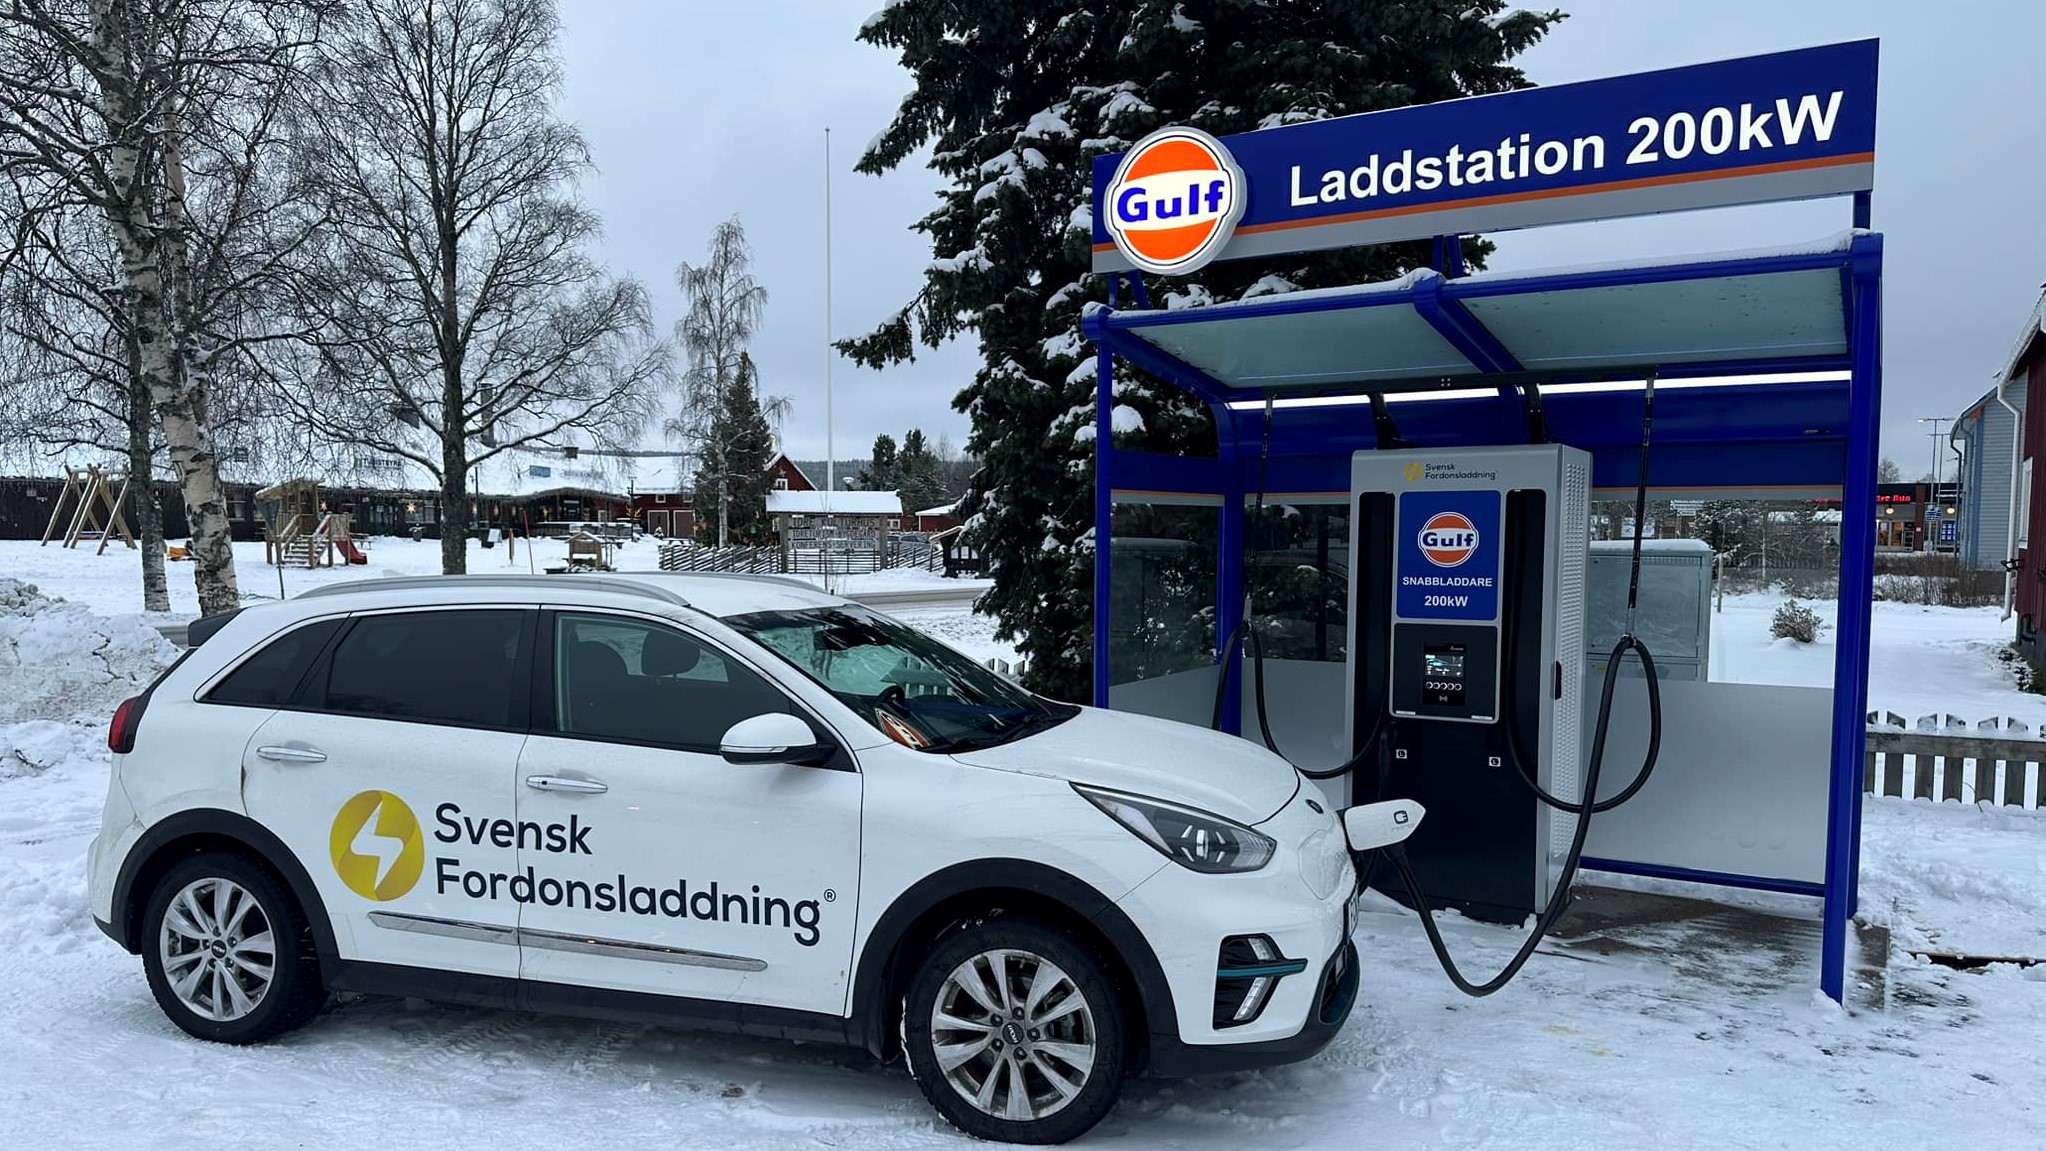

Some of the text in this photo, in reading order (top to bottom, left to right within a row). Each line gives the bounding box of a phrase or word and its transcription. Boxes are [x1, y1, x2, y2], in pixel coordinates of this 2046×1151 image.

[1290, 90, 1845, 208] Laddstation 200kW
[1117, 179, 1225, 223] Gulf
[1425, 463, 1455, 471] Svensk
[793, 517, 875, 527] IDRE KULTURHUS
[1422, 532, 1475, 547] Gulf
[1402, 576, 1493, 587] SNABBLADDARE
[1424, 595, 1469, 607] 200kW
[434, 803, 593, 855] Svensk
